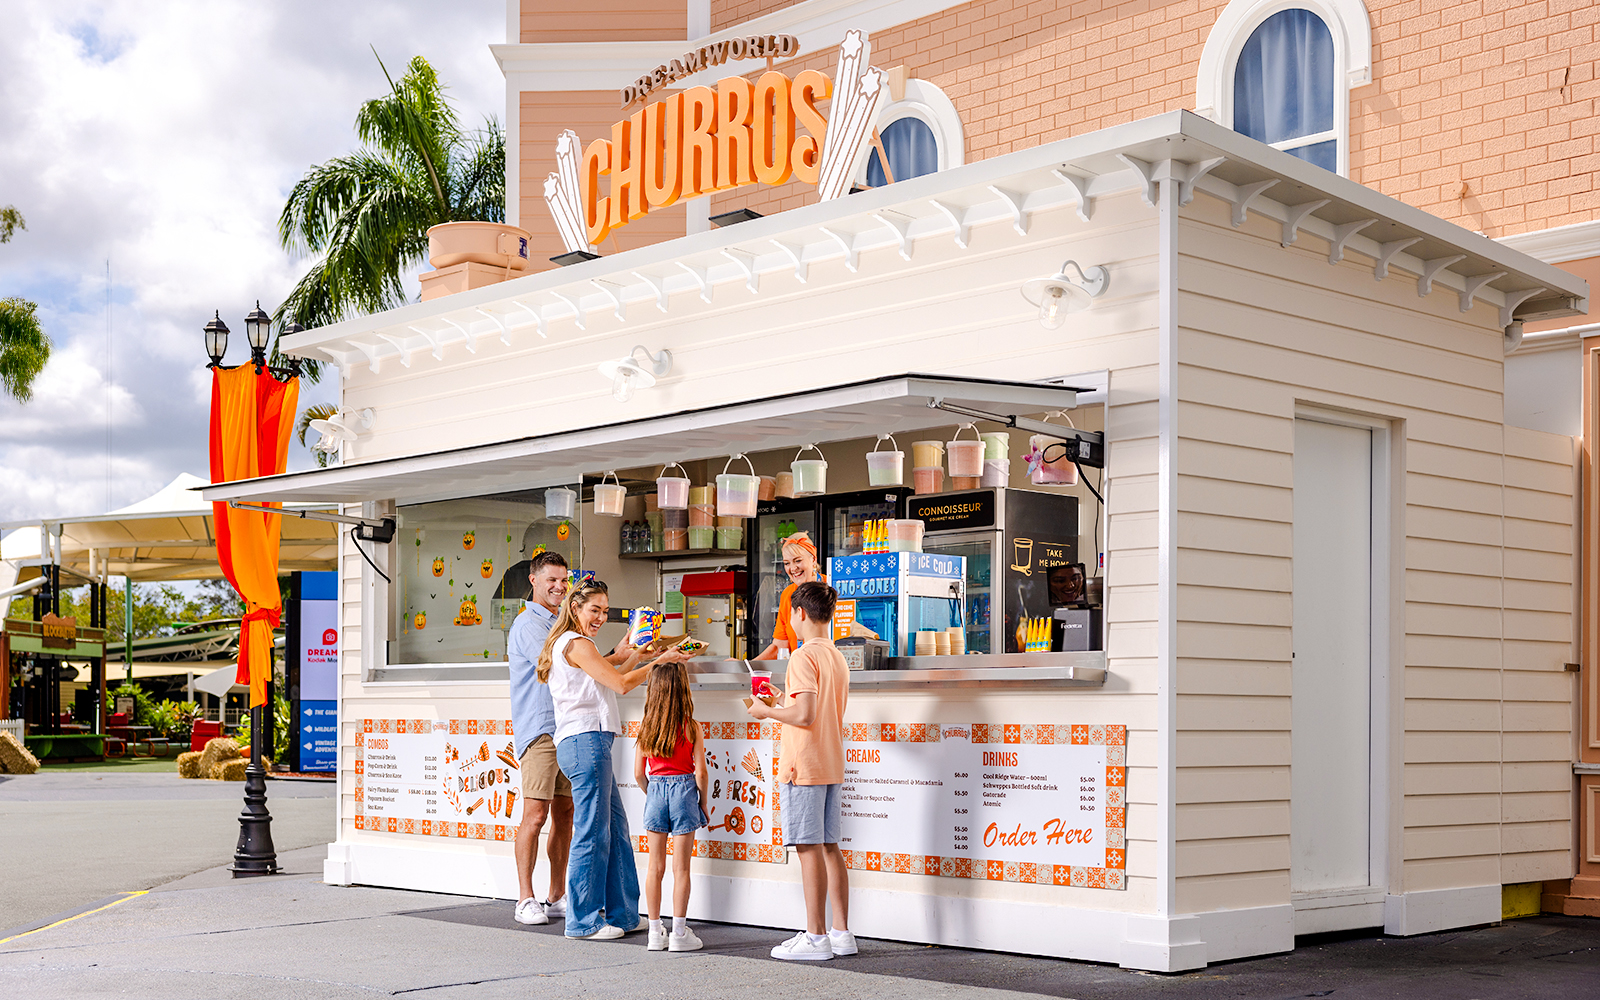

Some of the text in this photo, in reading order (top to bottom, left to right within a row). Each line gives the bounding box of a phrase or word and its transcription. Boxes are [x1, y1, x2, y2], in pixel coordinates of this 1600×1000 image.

[620, 33, 800, 110] DREAMWORLD
[579, 69, 834, 245] CHURROS
[918, 502, 981, 517] CONNOISSEUR
[1046, 548, 1062, 558] TAKE
[918, 556, 952, 574] ICE COLD
[1038, 559, 1048, 567] ME
[836, 578, 896, 596] SNO-CONES
[368, 738, 389, 749] COMBOS
[846, 749, 880, 763] CREAMS
[983, 752, 1018, 766] DRINKS
[458, 768, 510, 793] DELICIOUS
[712, 779, 721, 799] &
[983, 818, 1094, 848] Order Here
